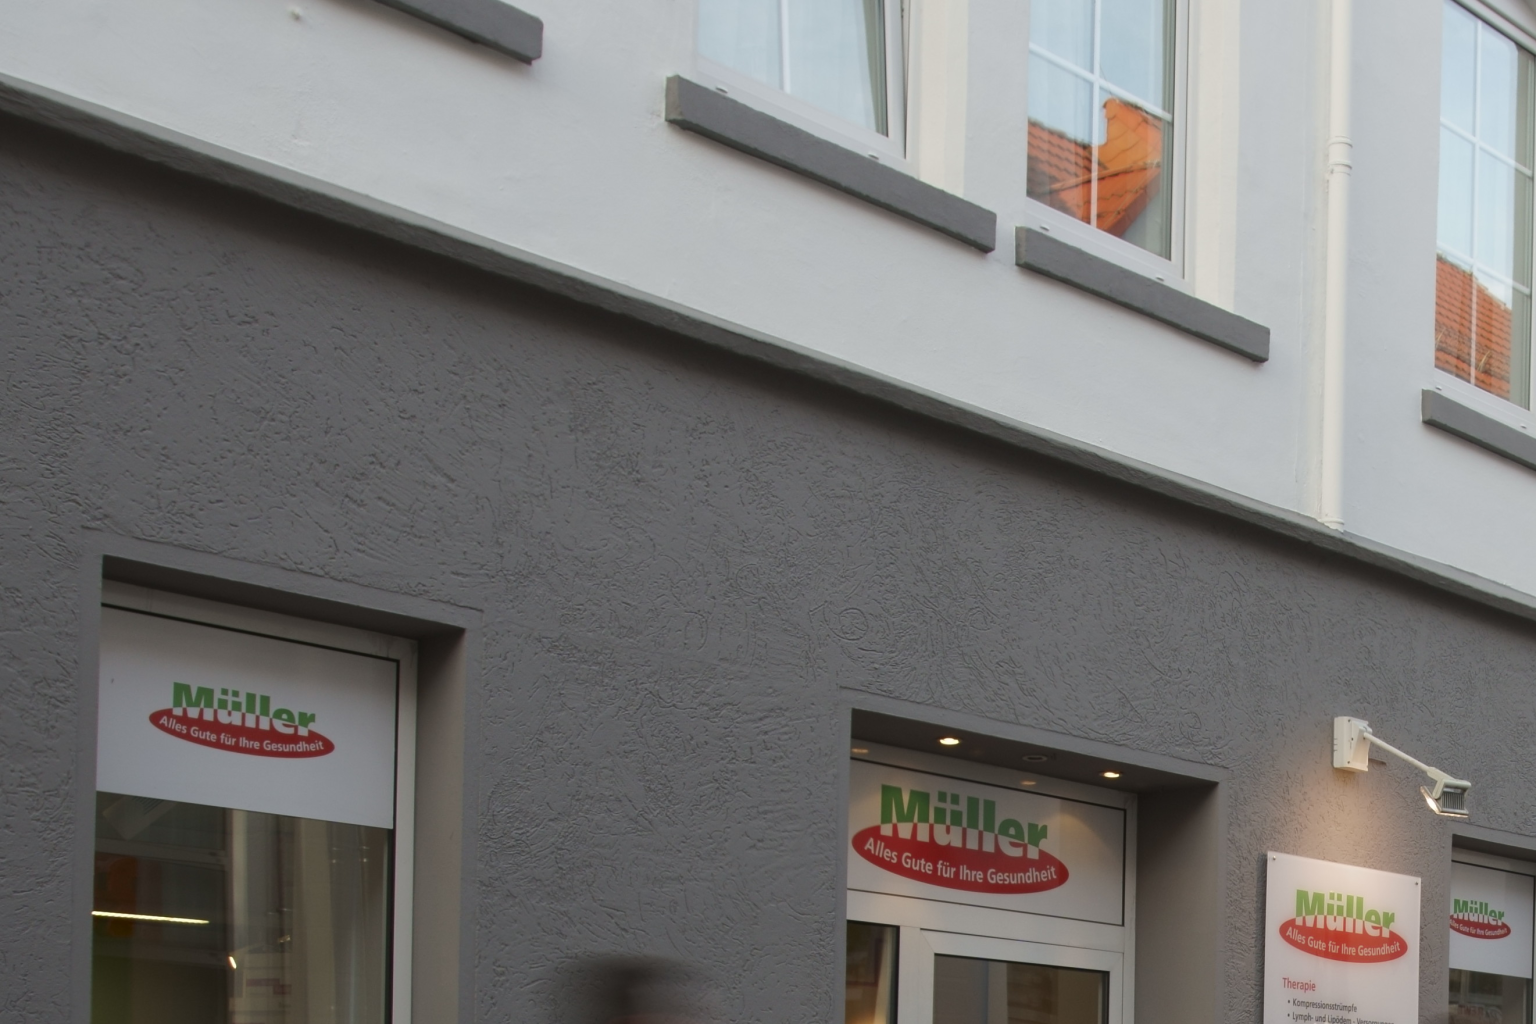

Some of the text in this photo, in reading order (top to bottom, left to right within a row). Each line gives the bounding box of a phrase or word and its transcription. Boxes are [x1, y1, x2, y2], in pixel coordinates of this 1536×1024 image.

[172, 681, 316, 737] Müller
[159, 715, 324, 752] Alles Gute für Ihre Gesundheit
[880, 783, 1048, 860] Müller
[864, 837, 1057, 885] Alles Gute für Ihre Gesundheit
[1295, 889, 1395, 938] Müller
[1453, 898, 1505, 926] Müller
[1286, 926, 1401, 957] Alles Gute für Ihre Gesundheit
[1282, 977, 1316, 993] Therapie
[1292, 998, 1358, 1013] Kompressionsstrümpfe
[1292, 1012, 1314, 1023] Lymph-
[1315, 1014, 1326, 1022] und
